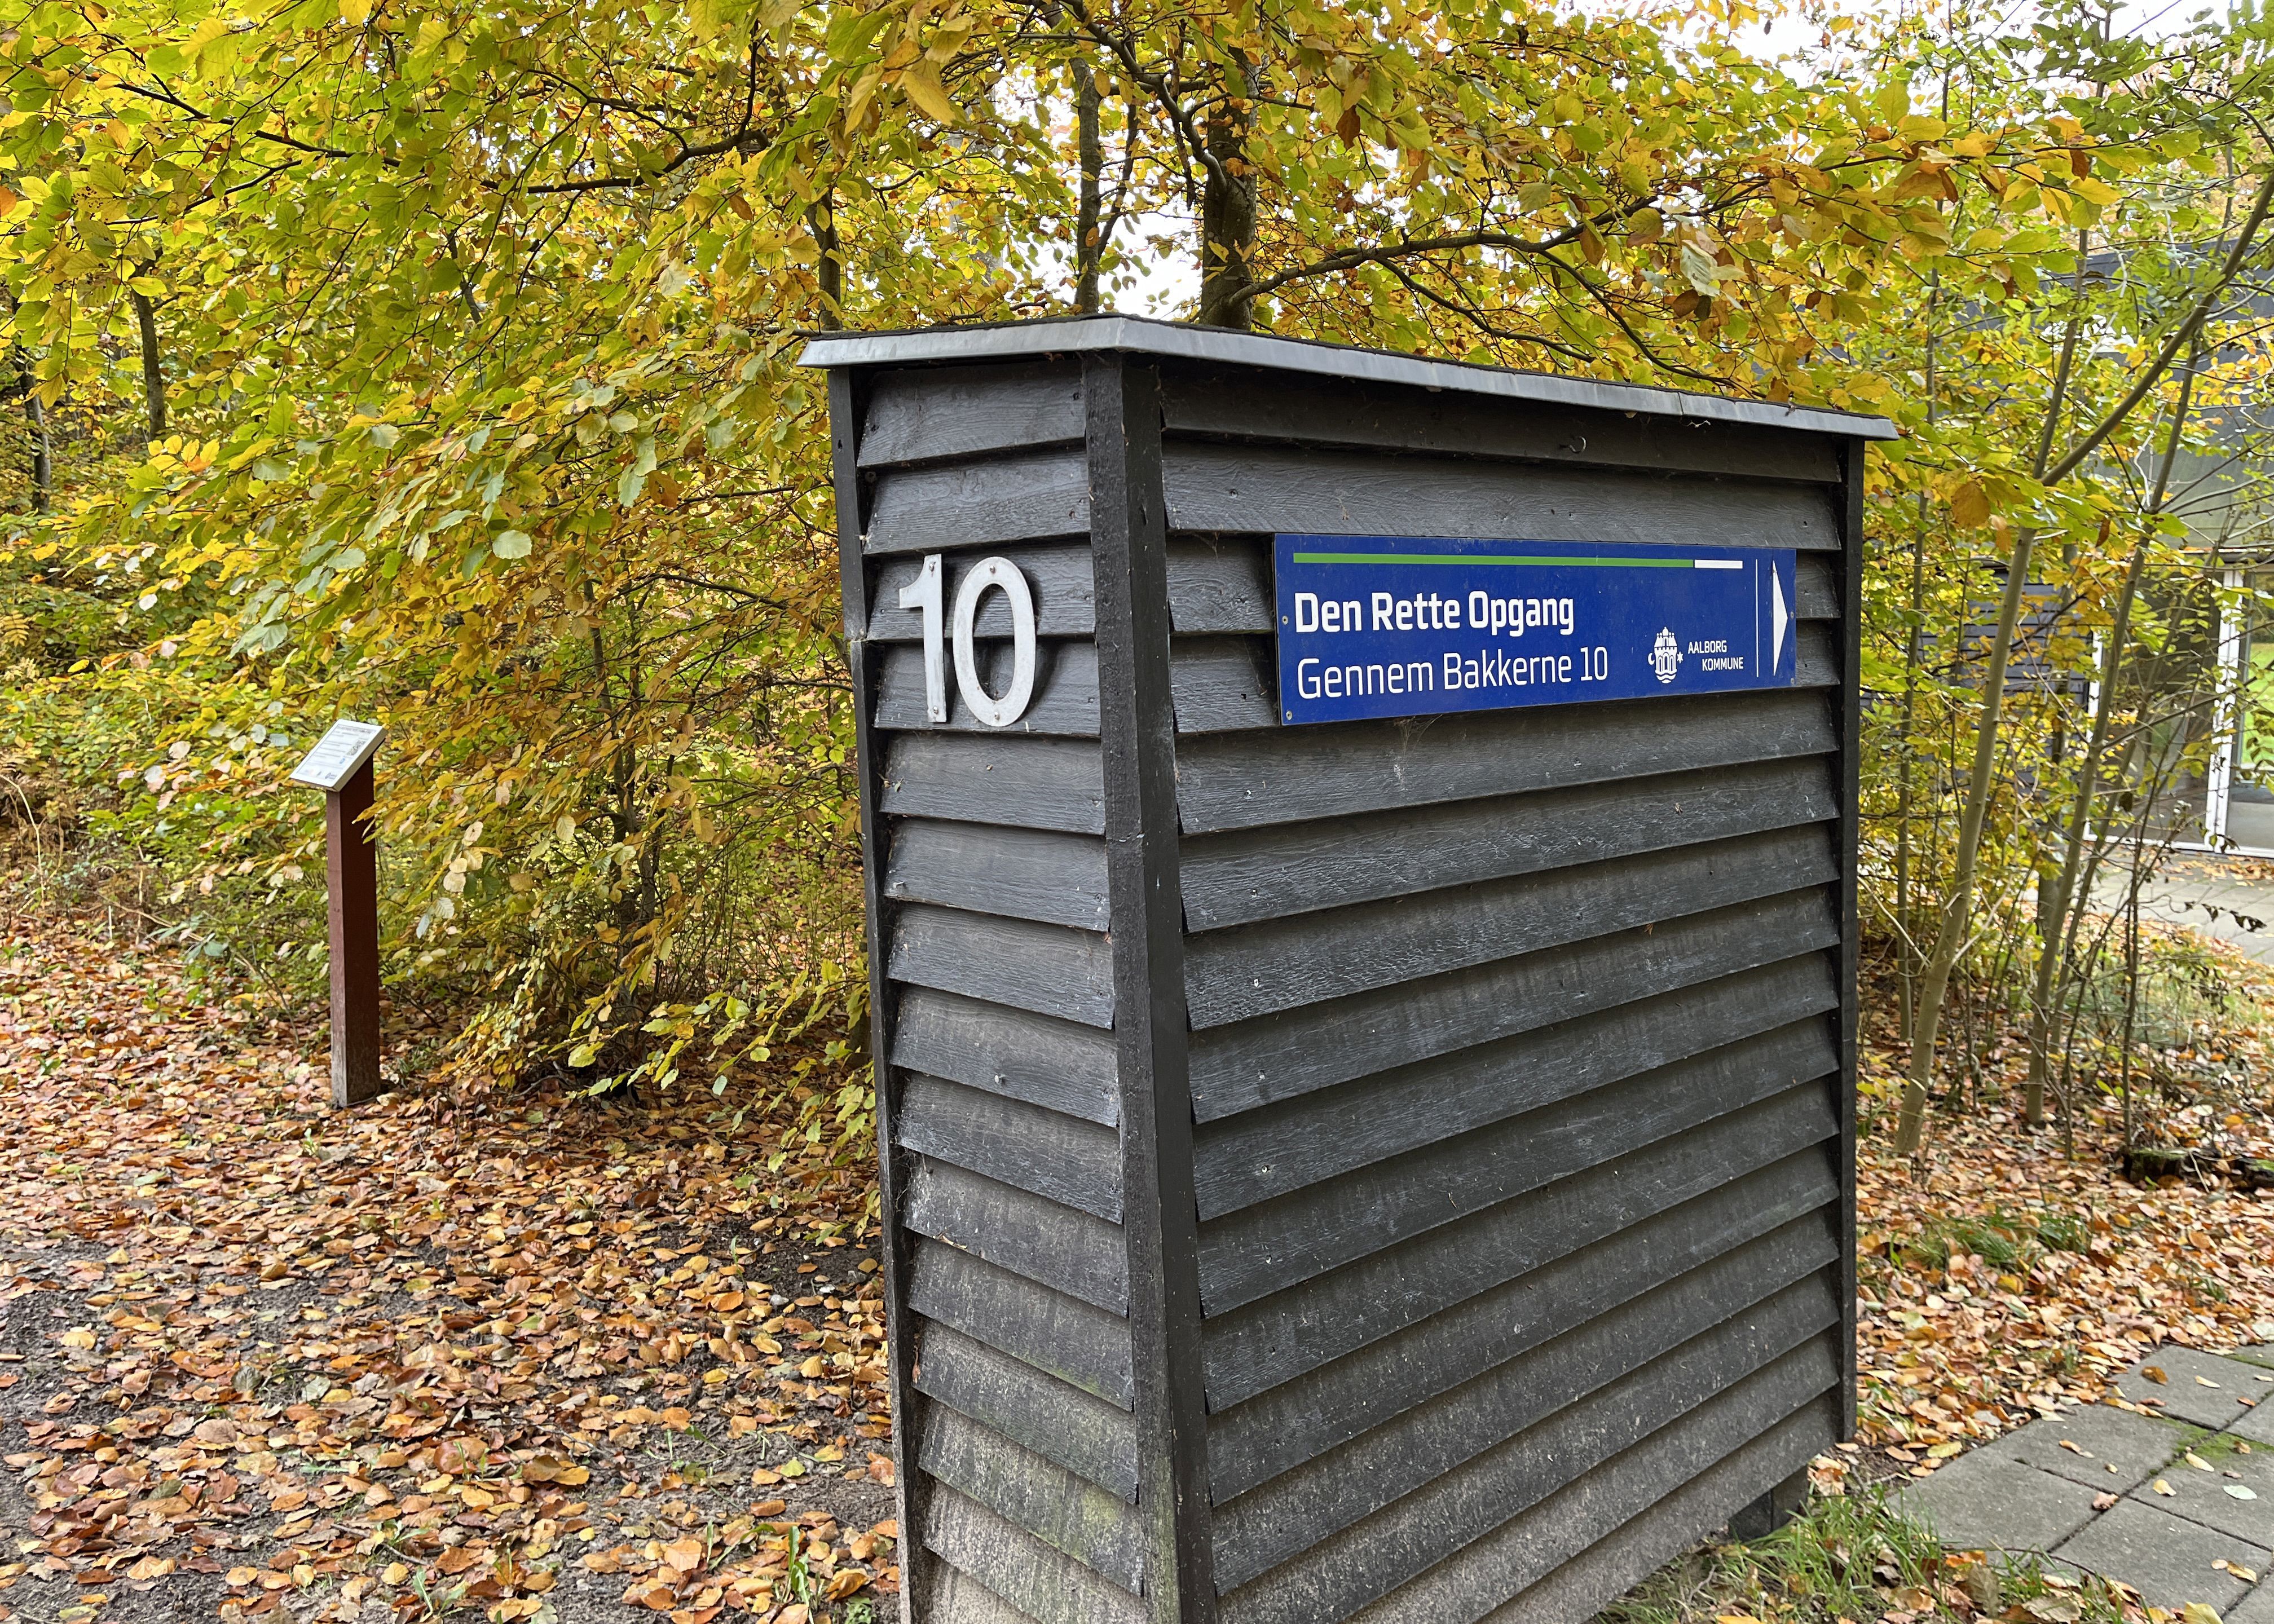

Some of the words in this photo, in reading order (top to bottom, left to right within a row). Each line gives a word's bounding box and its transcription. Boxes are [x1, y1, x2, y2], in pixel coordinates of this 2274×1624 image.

[1294, 592, 1362, 633] Den
[1372, 592, 1460, 631] Rette
[1469, 590, 1574, 637] Opgang
[899, 553, 1036, 727] 10
[1687, 640, 1727, 654] AALBORG
[1298, 657, 1433, 699] Gennem
[1443, 648, 1572, 690] Bakkerne
[1580, 646, 1608, 681] 10
[1702, 656, 1744, 672] KOMMUNE
